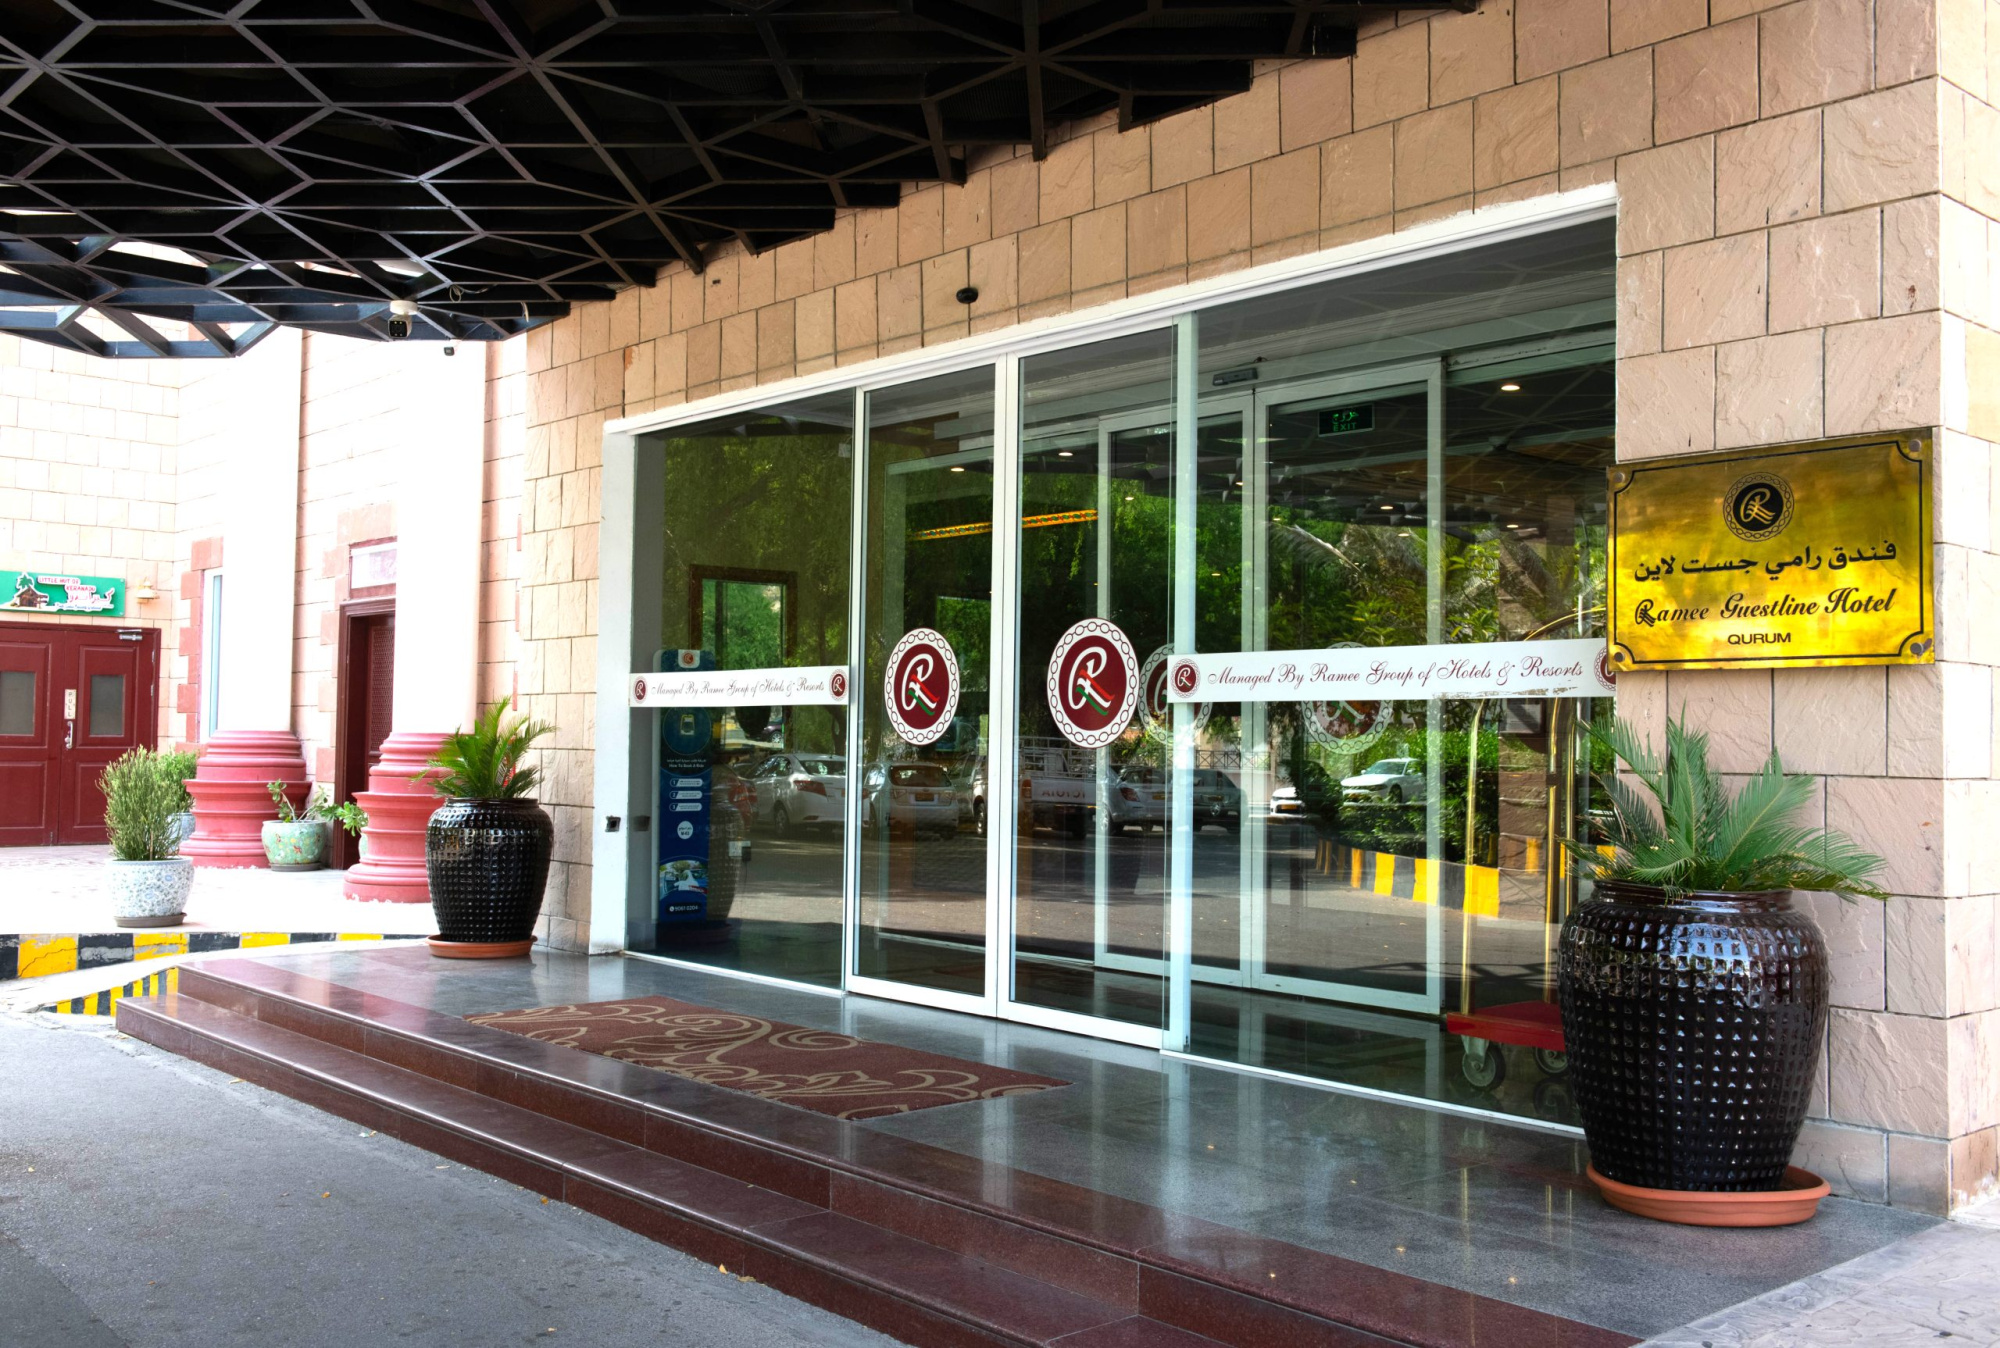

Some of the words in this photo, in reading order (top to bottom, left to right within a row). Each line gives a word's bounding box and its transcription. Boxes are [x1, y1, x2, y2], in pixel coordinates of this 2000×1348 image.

[1333, 423, 1357, 432] EXIT
[1682, 555, 1758, 575] جست
[1765, 546, 1822, 580] رامي
[1828, 540, 1897, 571] فندق
[1635, 556, 1676, 581] لاين
[1635, 598, 1709, 627] Ramee
[1720, 592, 1820, 619] Guestline
[1824, 587, 1897, 615] Hotel
[1727, 632, 1791, 645] QURUM
[1208, 666, 1275, 690] Managed
[1278, 663, 1304, 690] By
[1310, 663, 1360, 683] Ramee
[1366, 661, 1414, 686] Group
[1417, 662, 1436, 687] of
[1436, 659, 1492, 679] Hotels
[1496, 661, 1515, 685] &
[1521, 656, 1583, 678] Resorts
[651, 682, 684, 699] Managed
[685, 681, 698, 699] By
[701, 681, 724, 694] Ramee
[727, 679, 749, 697] Group
[750, 680, 760, 697] of
[760, 679, 784, 693] Hotels
[785, 680, 796, 697] &
[797, 677, 824, 692] Resorts
